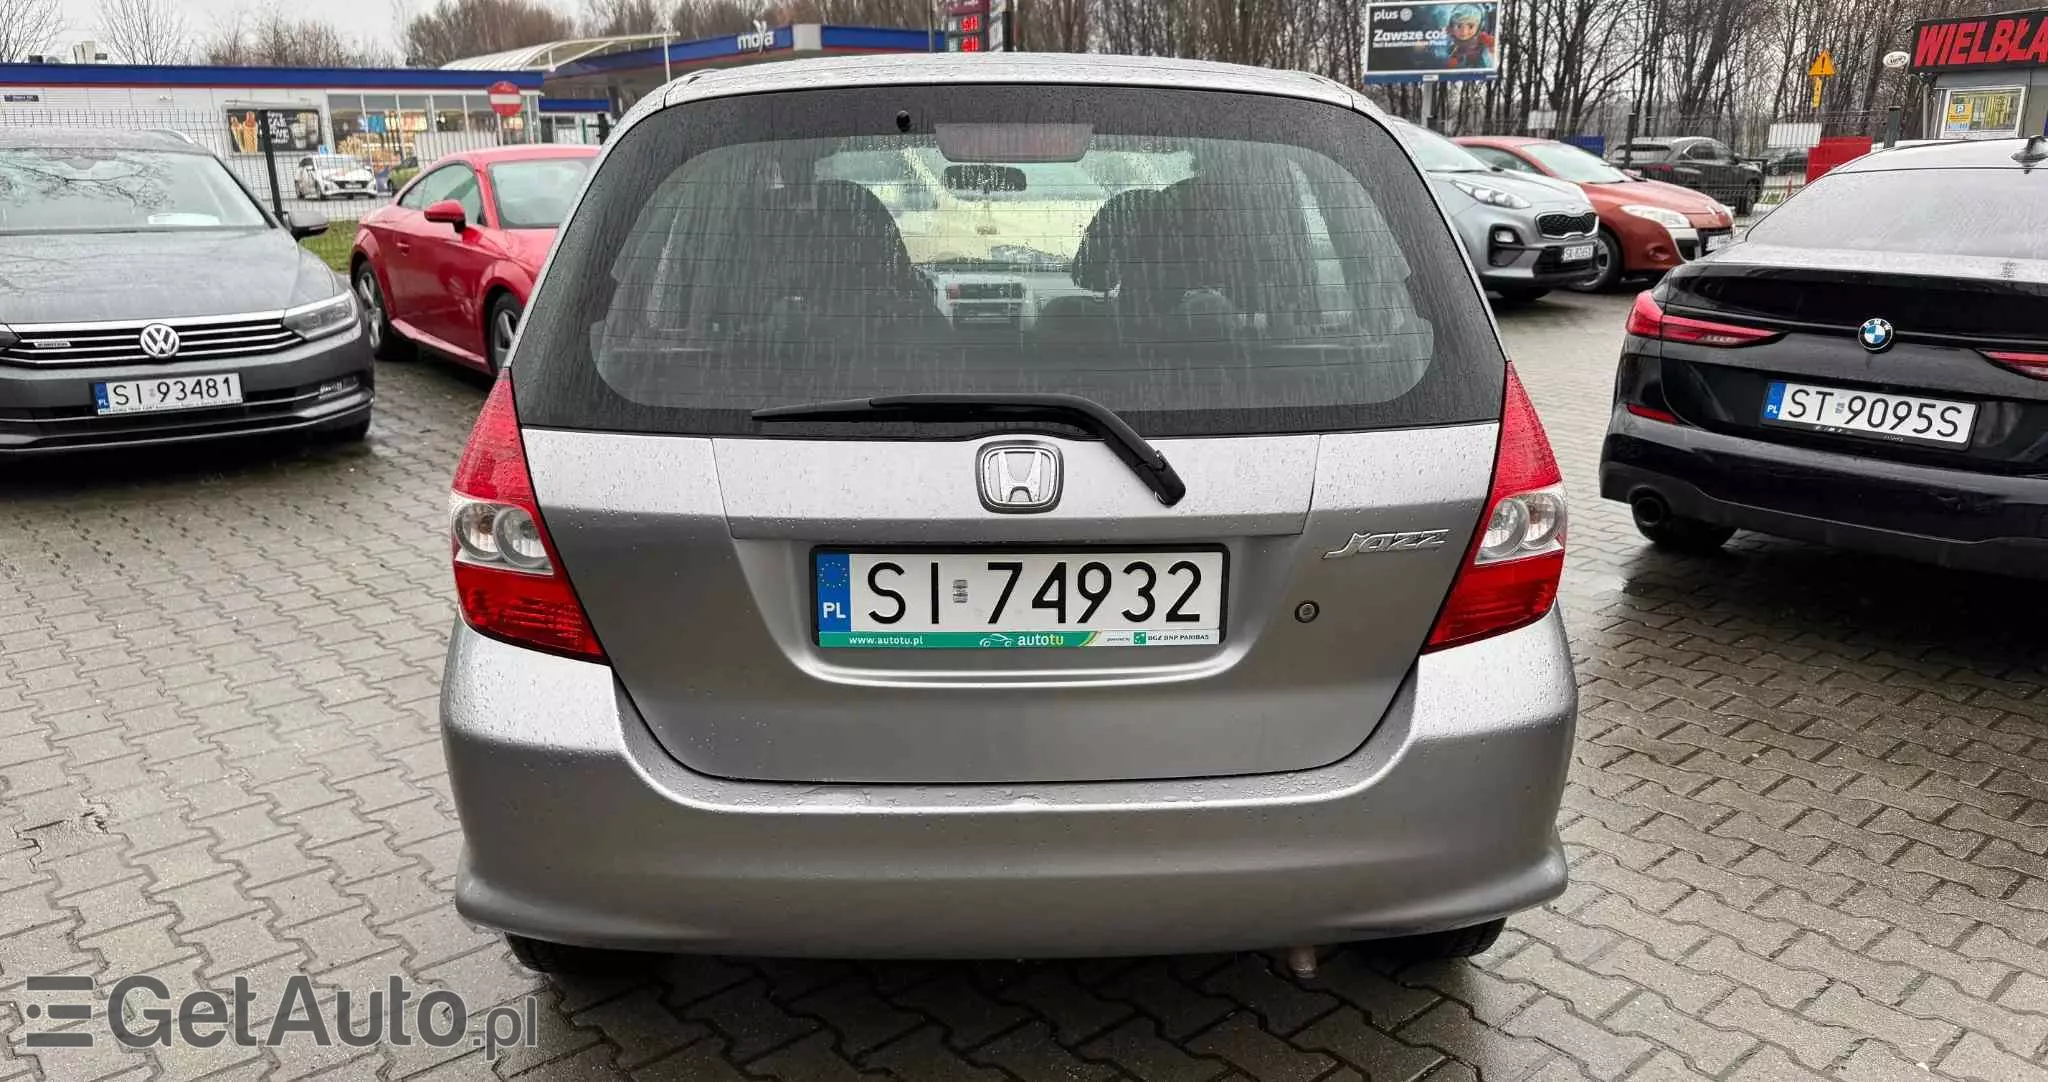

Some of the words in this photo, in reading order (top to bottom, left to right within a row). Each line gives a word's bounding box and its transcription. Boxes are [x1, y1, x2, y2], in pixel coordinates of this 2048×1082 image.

[1373, 8, 1398, 21] plus
[1373, 28, 1424, 41] Zawsze
[113, 383, 142, 406] SI
[156, 376, 232, 403] 93481
[1766, 403, 1779, 415] PL
[1788, 389, 1834, 421] ST
[1844, 395, 1962, 438] 9095S
[867, 560, 939, 625] SI
[987, 560, 1202, 625] 74932
[822, 602, 847, 619] PL
[848, 635, 924, 647] www.autotu.pl
[1017, 633, 1065, 647] autotu
